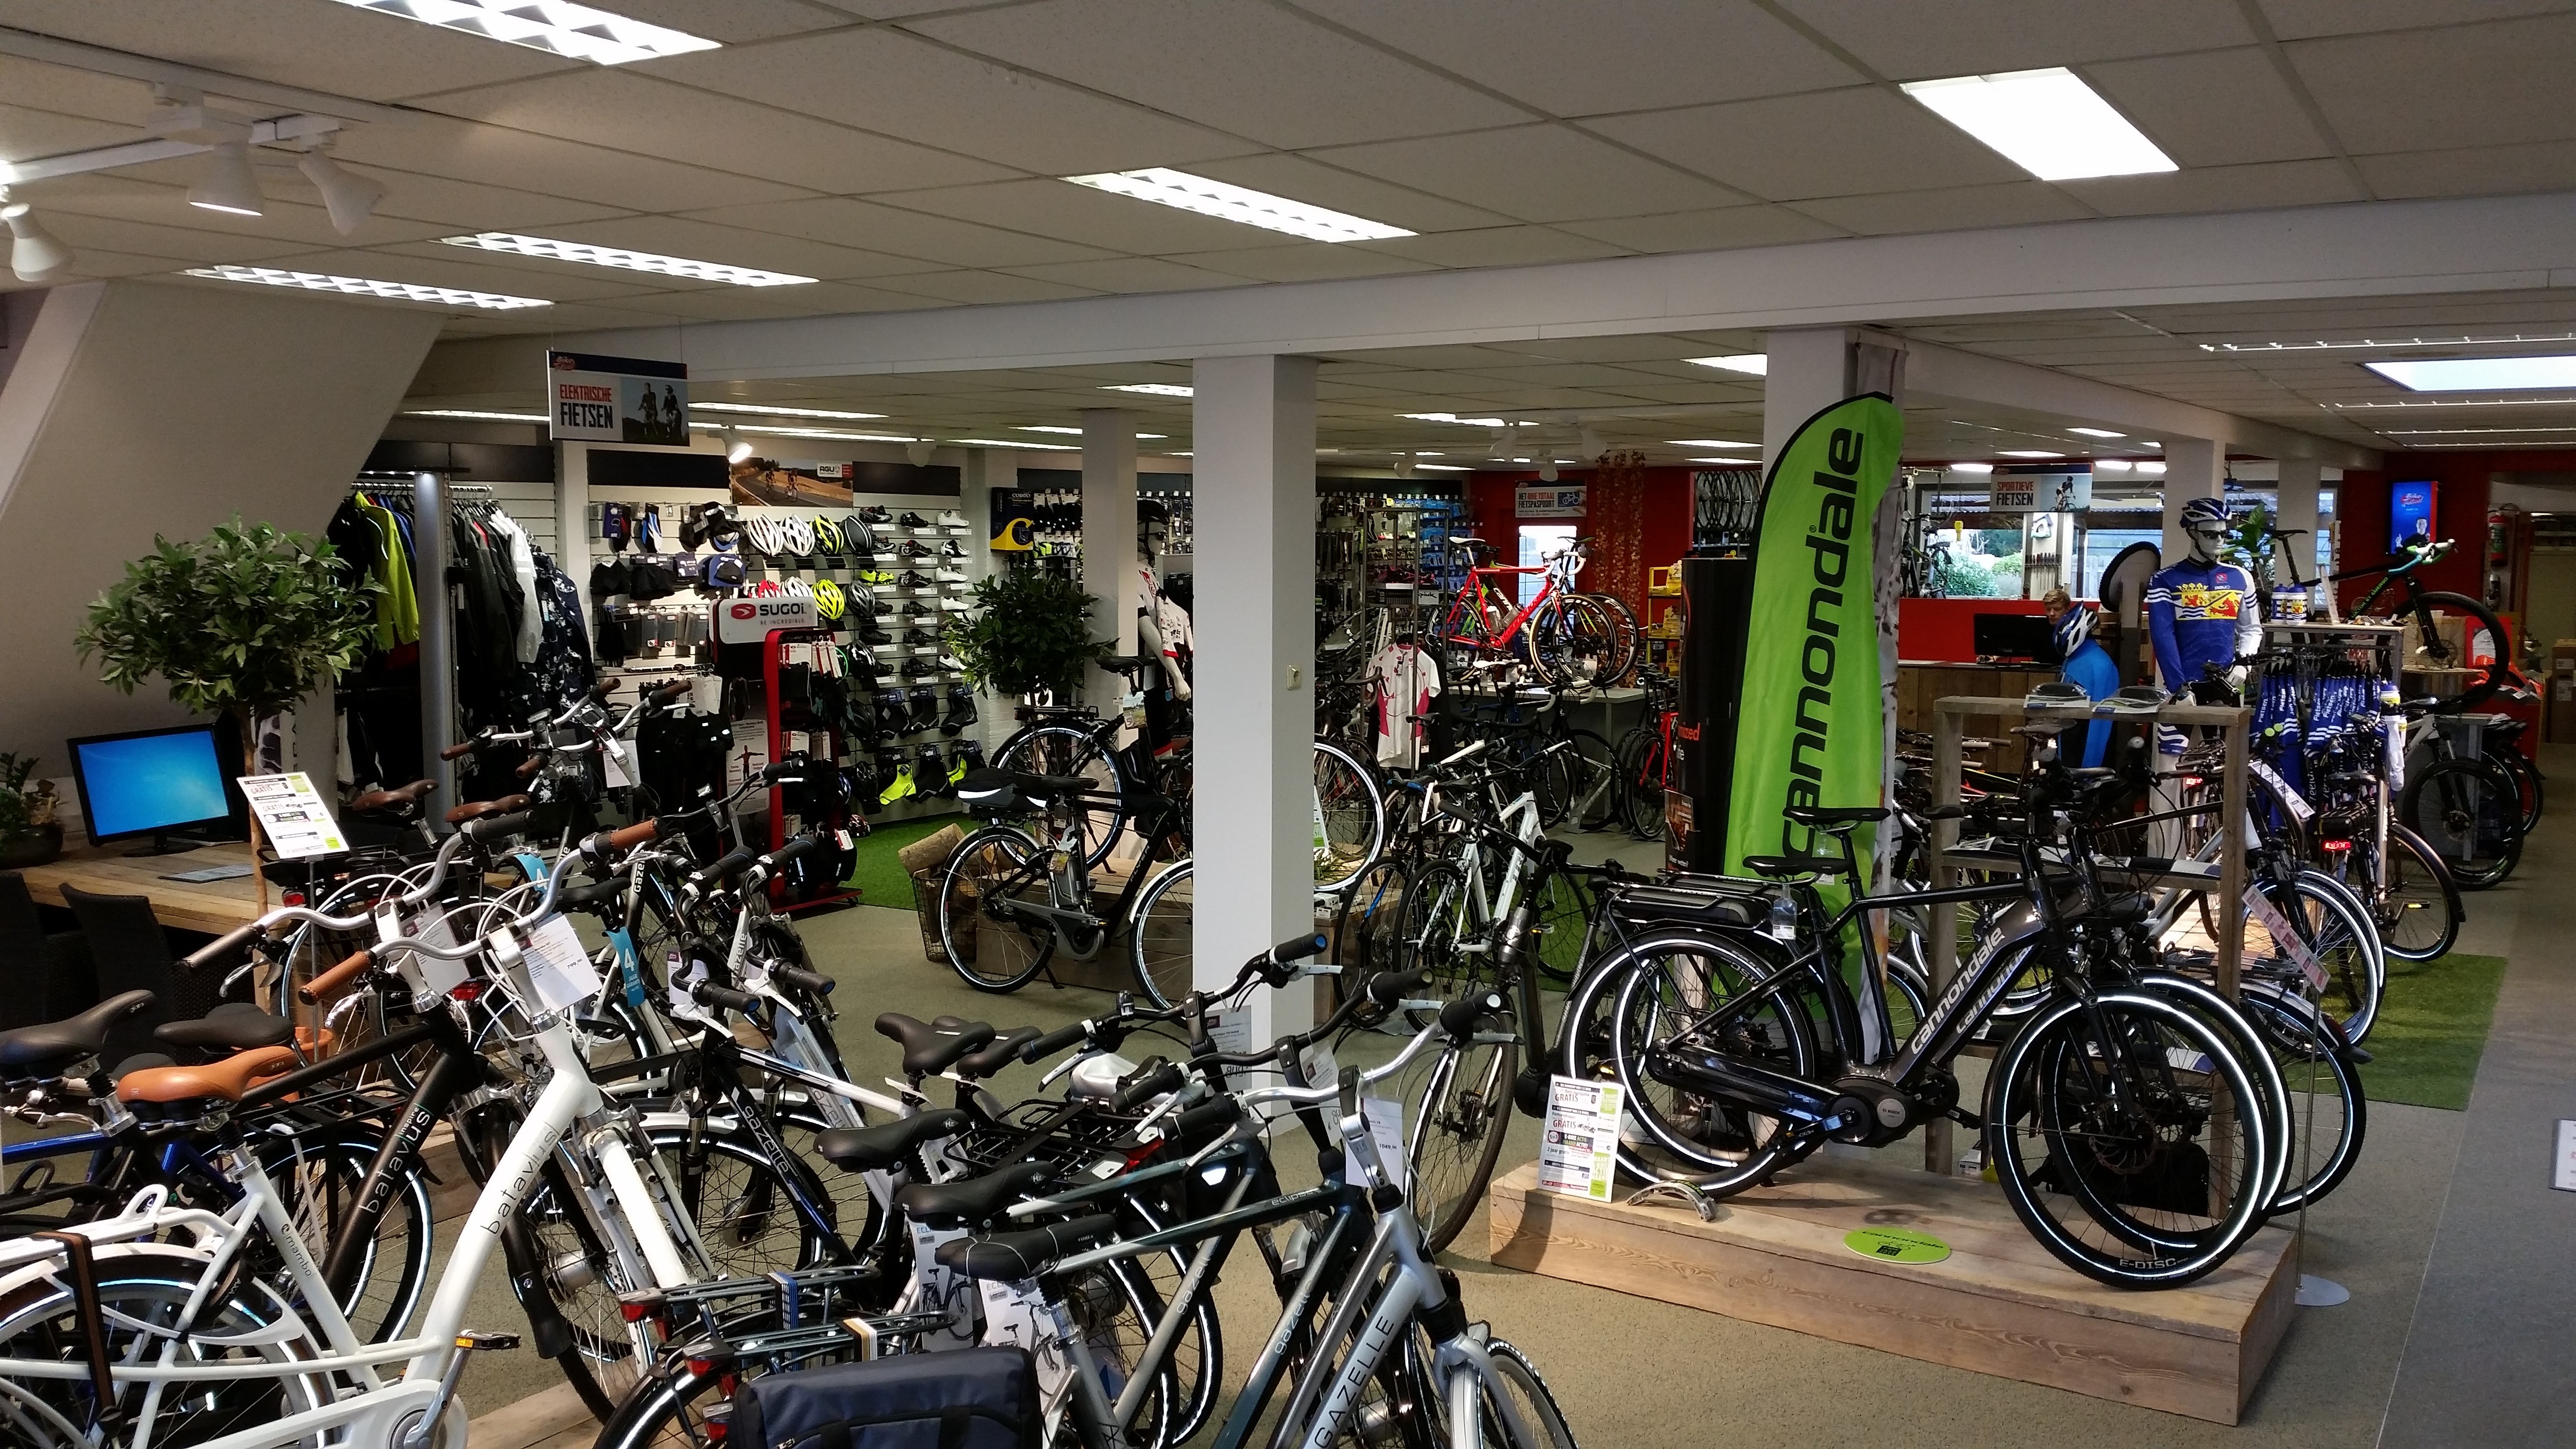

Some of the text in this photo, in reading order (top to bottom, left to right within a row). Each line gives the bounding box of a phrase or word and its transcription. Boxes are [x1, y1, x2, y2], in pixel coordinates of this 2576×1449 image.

[560, 384, 612, 402] ELEKTRISCHE
[560, 402, 613, 429] FIETSEN
[1996, 481, 2034, 491] SPORTIEVE
[1518, 500, 1555, 508] FIETSPASPOORT
[1996, 492, 2034, 506] FIETSEN
[1783, 426, 1863, 859] cannondale
[251, 785, 273, 794] GRATIS
[624, 948, 635, 971] 4
[1911, 927, 2003, 1054] cannondale
[1555, 1094, 1578, 1102] GRATIS
[1553, 1119, 1576, 1129] GRATIS
[744, 1106, 789, 1173] gazelle
[357, 1111, 430, 1213] batavus
[480, 1130, 557, 1234] batavus
[1862, 1231, 1944, 1249] cannondale
[2120, 1257, 2176, 1269] E-DISC
[1314, 1316, 1394, 1449] GAZELLE
